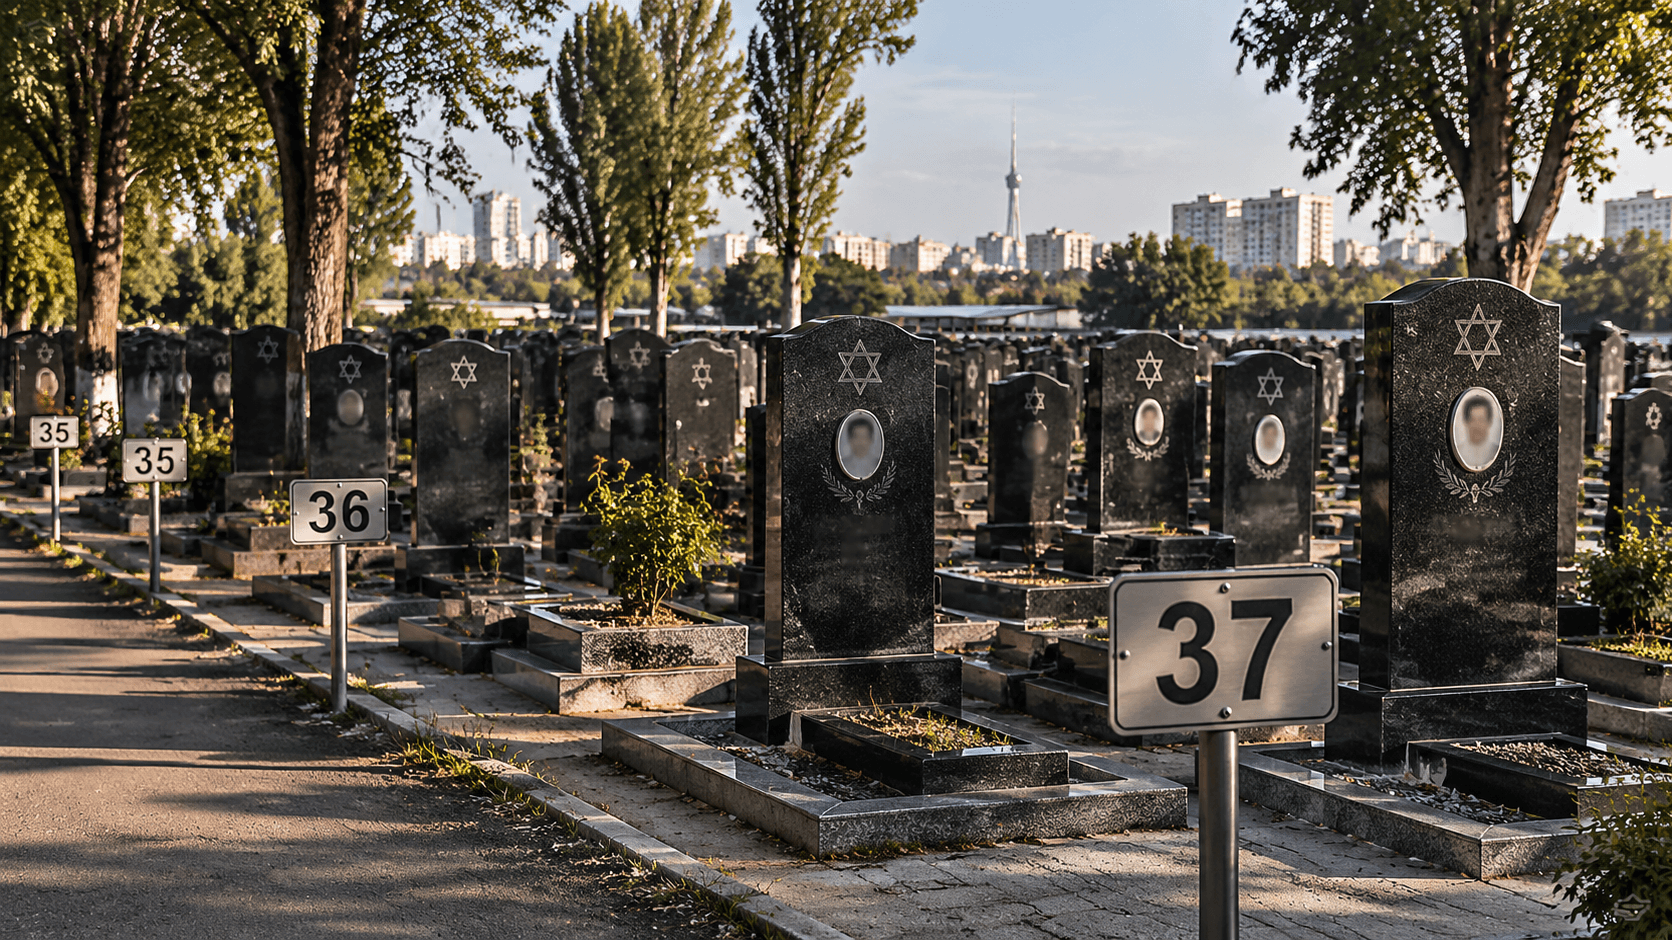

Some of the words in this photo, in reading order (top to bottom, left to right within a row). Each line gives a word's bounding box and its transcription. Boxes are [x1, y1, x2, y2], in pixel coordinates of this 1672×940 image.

[40, 422, 69, 442] 35
[135, 447, 175, 474] 35
[309, 490, 370, 533] 36
[1156, 598, 1293, 705] 37
